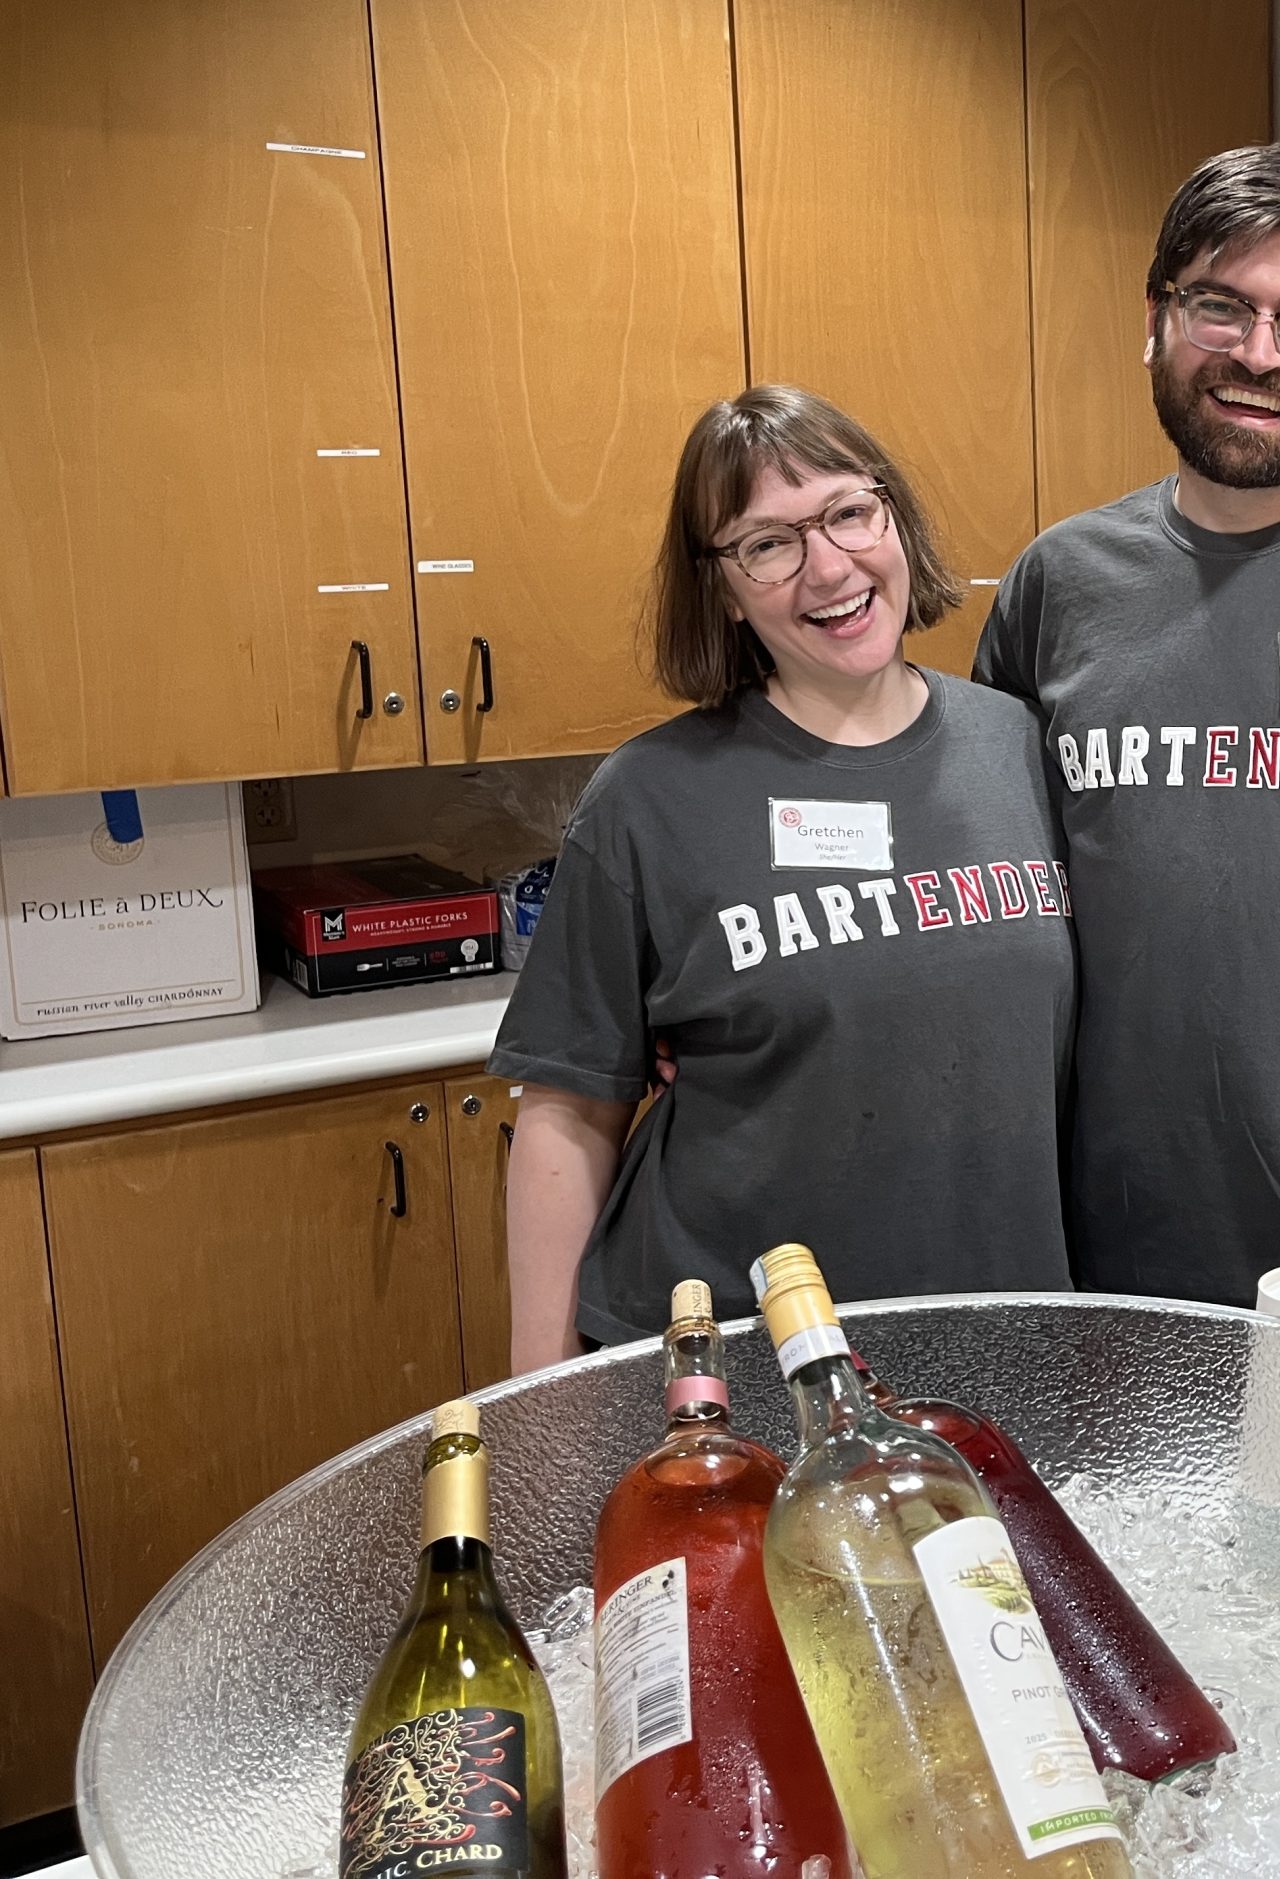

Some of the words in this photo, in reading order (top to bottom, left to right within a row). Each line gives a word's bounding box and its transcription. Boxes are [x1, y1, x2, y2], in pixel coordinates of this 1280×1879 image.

[797, 825, 865, 839] Gretchen
[814, 842, 849, 852] Wagner
[20, 897, 107, 924] FOLIE
[139, 886, 225, 913] DEUX
[98, 919, 154, 931] SONOMA
[352, 921, 387, 933] WHITE
[390, 915, 433, 929] PLASTIC
[435, 911, 469, 923] FORKS
[36, 1004, 80, 1017] russian
[83, 1000, 111, 1012] river
[113, 994, 145, 1009] valley
[990, 1621, 1047, 1662] CAV
[1011, 1685, 1051, 1703] PINOT
[1040, 1811, 1097, 1834] IMPORTED
[416, 1843, 503, 1870] CHARD
